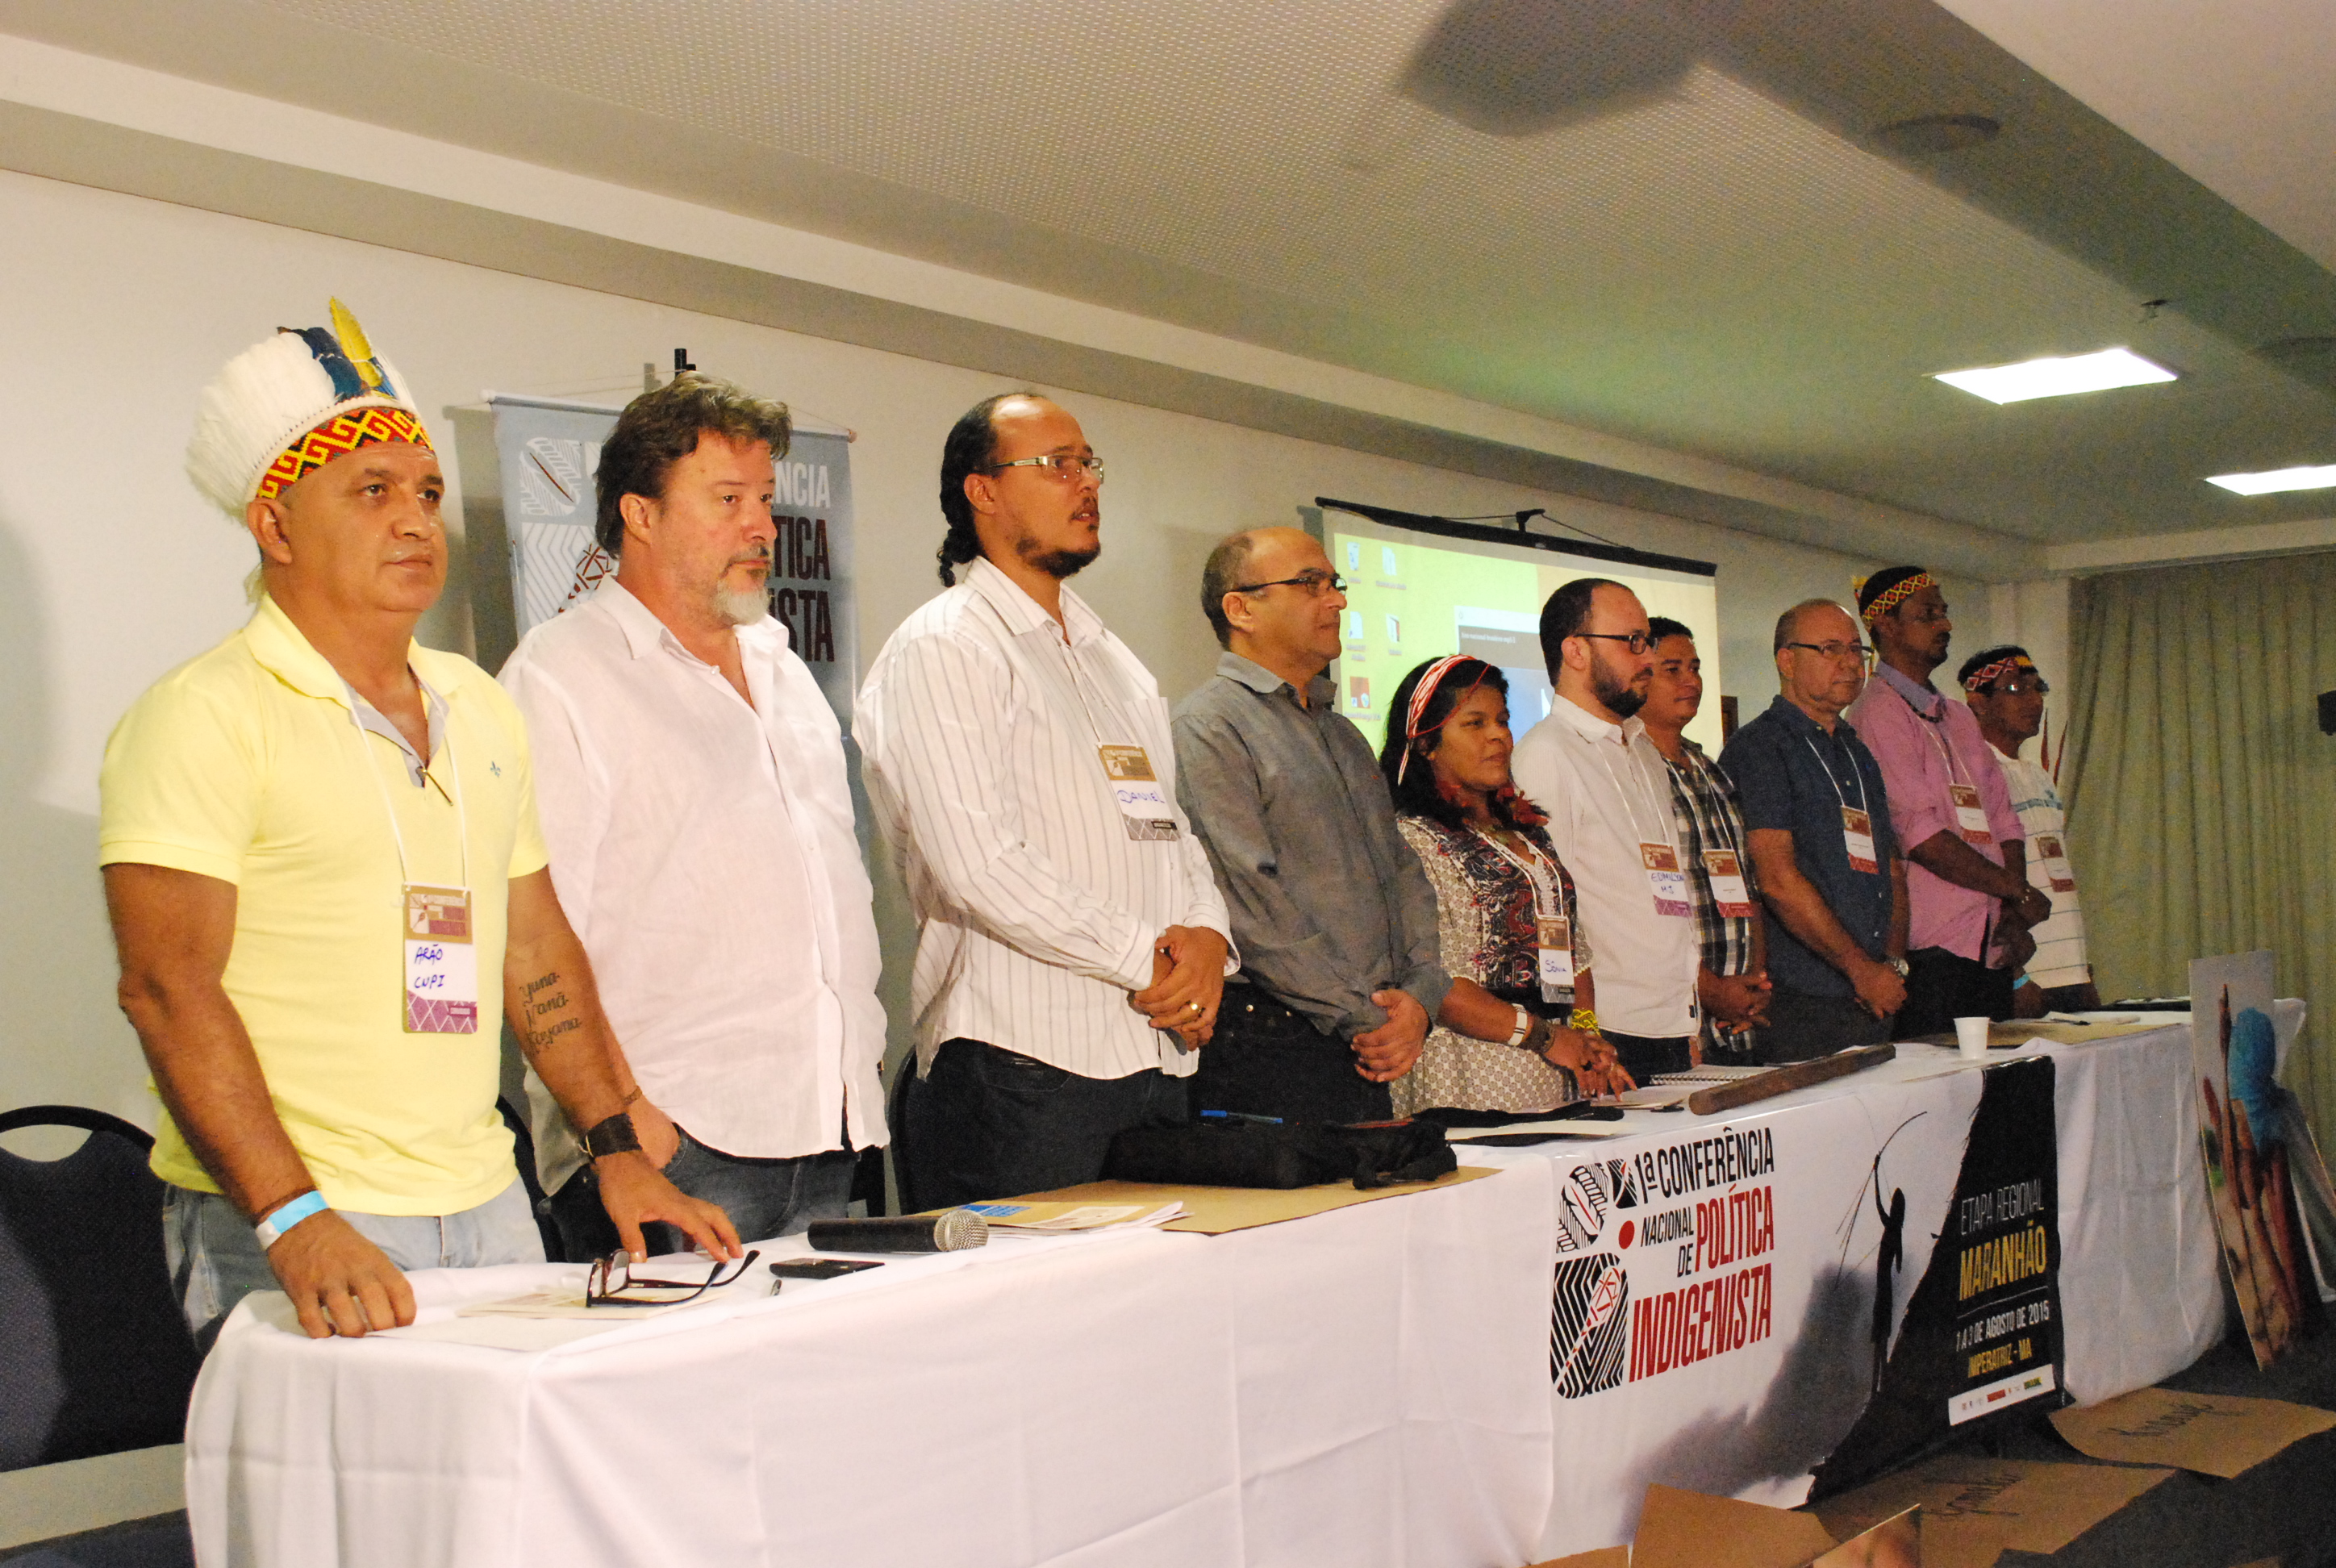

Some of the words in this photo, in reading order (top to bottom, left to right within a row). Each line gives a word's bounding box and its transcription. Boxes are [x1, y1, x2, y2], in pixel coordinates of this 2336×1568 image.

[1117, 790, 1165, 804] DANIEL
[1657, 1126, 1775, 1198] CONFERÊNCIA
[1641, 1207, 1694, 1247] NACIONAL
[1695, 1183, 1775, 1272] POLÍTICA
[1961, 1191, 1993, 1235] ETAPA
[1996, 1178, 2045, 1223] REGIONAL
[1677, 1243, 1694, 1278] DE
[1959, 1220, 2047, 1301] MARANHÃO
[1629, 1263, 1772, 1382] INDIGENISTA
[1974, 1320, 1984, 1344] DE
[1985, 1310, 2016, 1339] AGOSTO
[2017, 1306, 2026, 1329] DE
[2028, 1299, 2050, 1325] 2015
